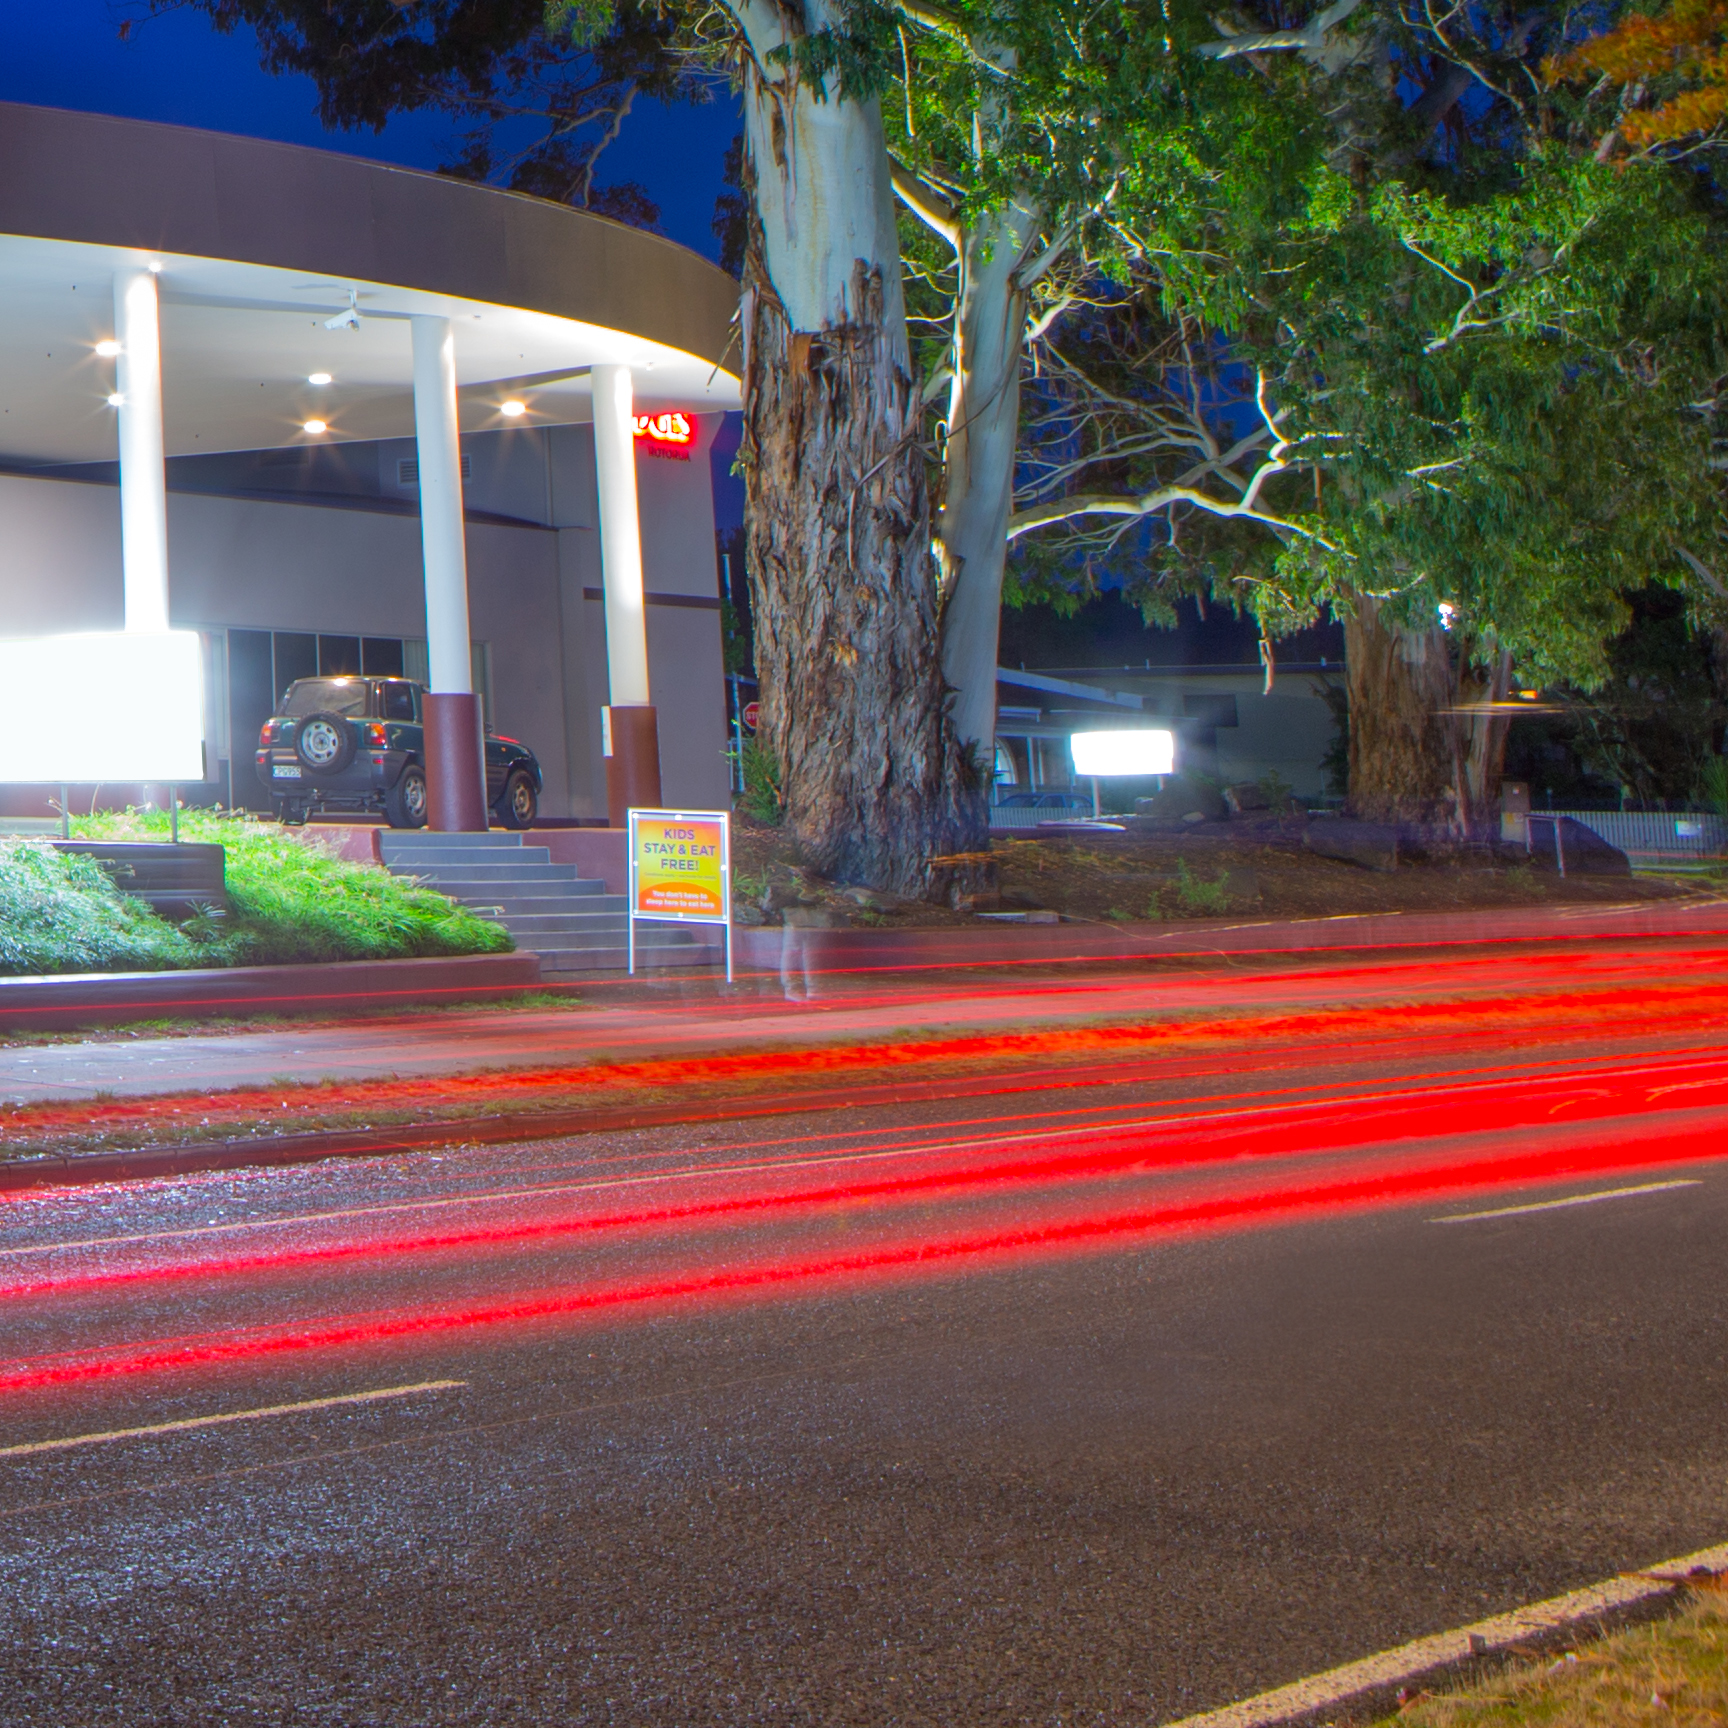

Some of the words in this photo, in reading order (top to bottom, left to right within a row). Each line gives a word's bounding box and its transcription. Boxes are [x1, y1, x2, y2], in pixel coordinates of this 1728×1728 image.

[663, 828, 695, 840] KIDS
[644, 842, 675, 854] STAY
[678, 844, 686, 855] &
[690, 845, 716, 856] EAT
[661, 858, 699, 871] FREE!
[652, 890, 665, 898] You
[665, 890, 683, 899] don't
[683, 892, 699, 900] have
[699, 892, 708, 901] to
[646, 898, 663, 907] sleep
[664, 899, 679, 907] here
[679, 900, 687, 908] to
[687, 901, 699, 909] eat
[699, 901, 715, 909] here
